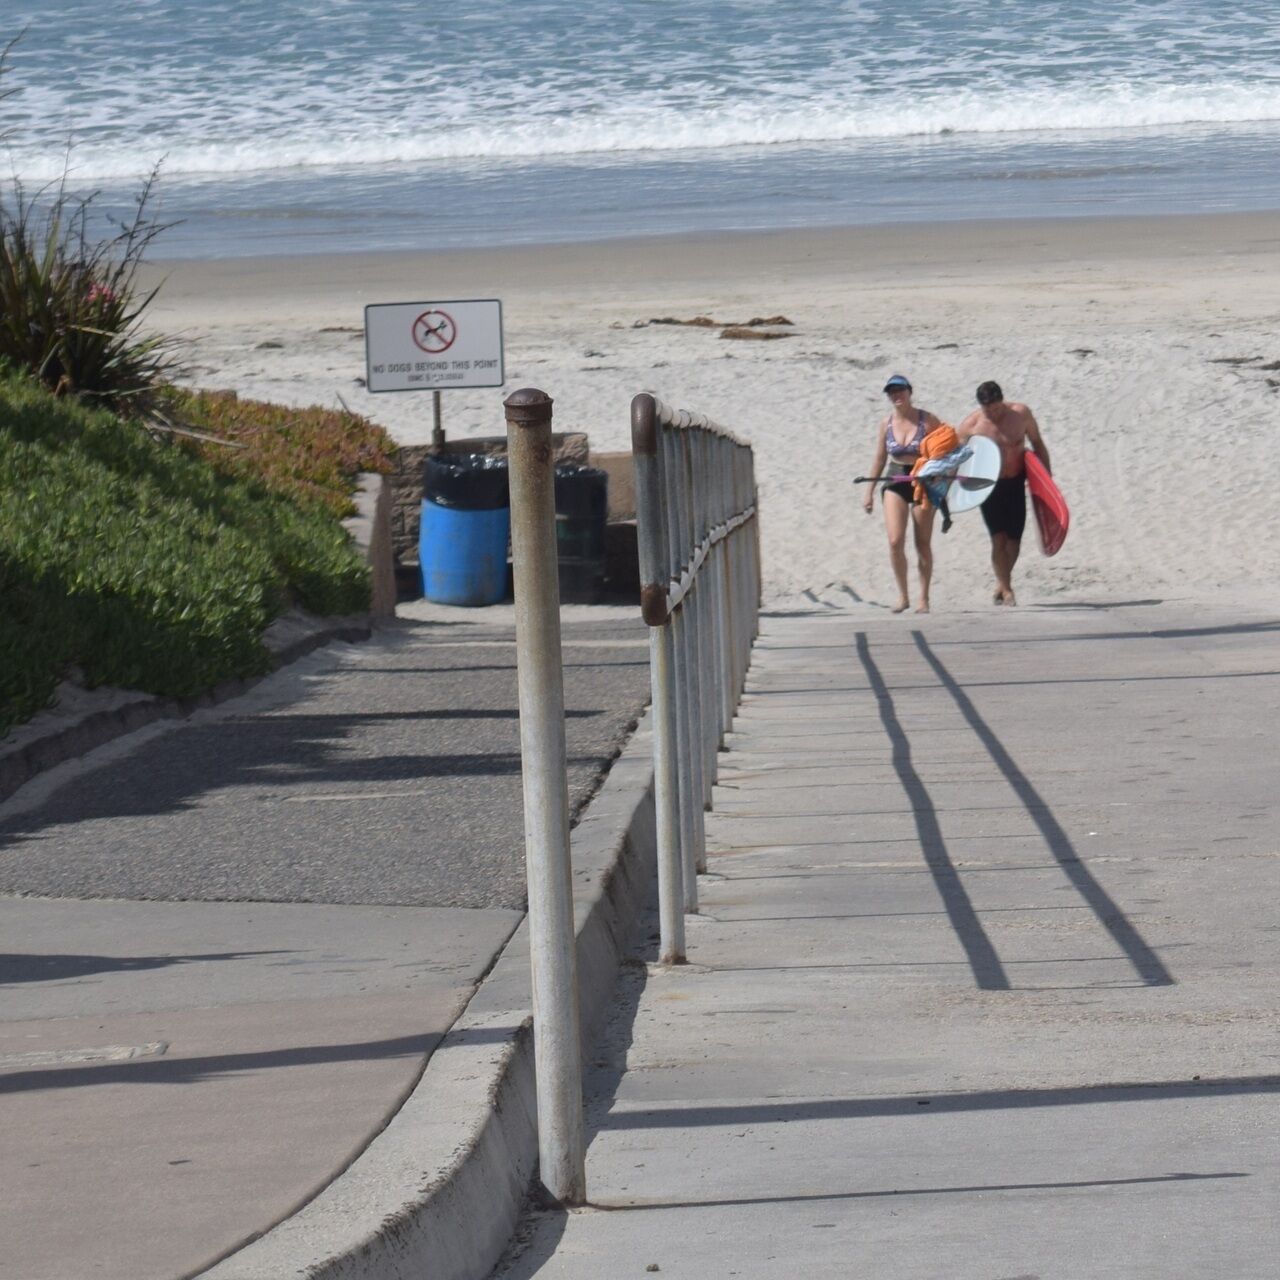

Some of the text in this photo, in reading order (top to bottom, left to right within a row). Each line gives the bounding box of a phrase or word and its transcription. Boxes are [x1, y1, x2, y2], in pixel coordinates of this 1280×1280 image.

[373, 360, 497, 373] NO DOGS BEYOND THIS POINT
